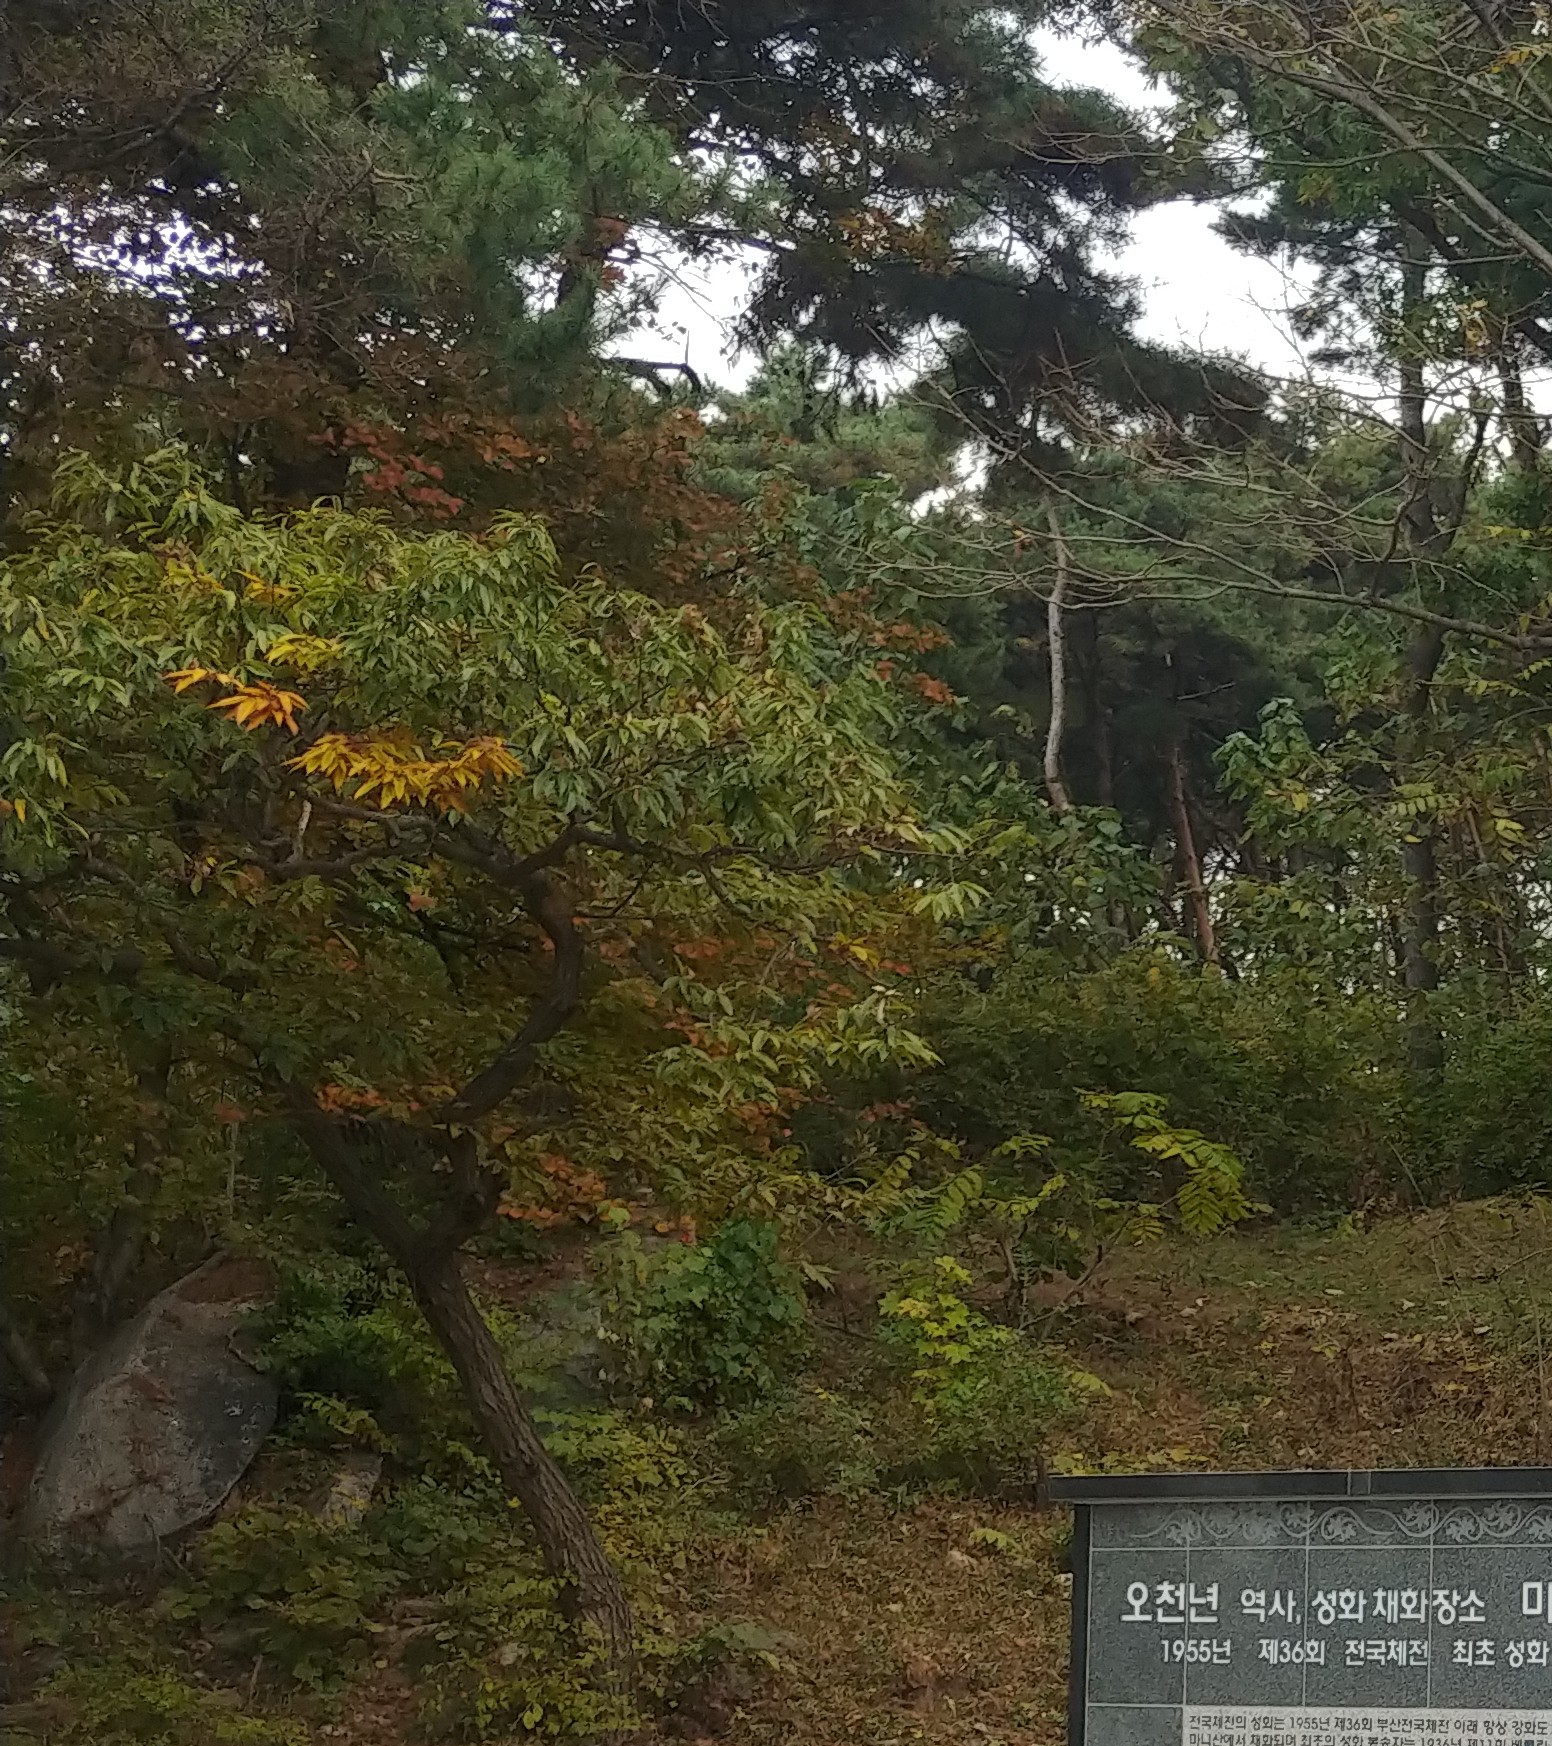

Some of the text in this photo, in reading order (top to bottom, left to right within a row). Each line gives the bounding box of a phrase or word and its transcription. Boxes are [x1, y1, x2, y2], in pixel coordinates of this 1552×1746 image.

[1121, 1581, 1218, 1623] 오천년
[1312, 1589, 1367, 1625] 성화
[1161, 1639, 1231, 1663] 1955년
[1258, 1639, 1325, 1665] 제36회
[1345, 1639, 1428, 1666] 전국체전
[1453, 1639, 1496, 1666] 최초
[1504, 1639, 1550, 1668] 성화
[1289, 1716, 1330, 1731] 1955년
[1334, 1716, 1372, 1732] 제36회
[1484, 1720, 1507, 1736] 항상
[1512, 1720, 1548, 1736] 강화도
